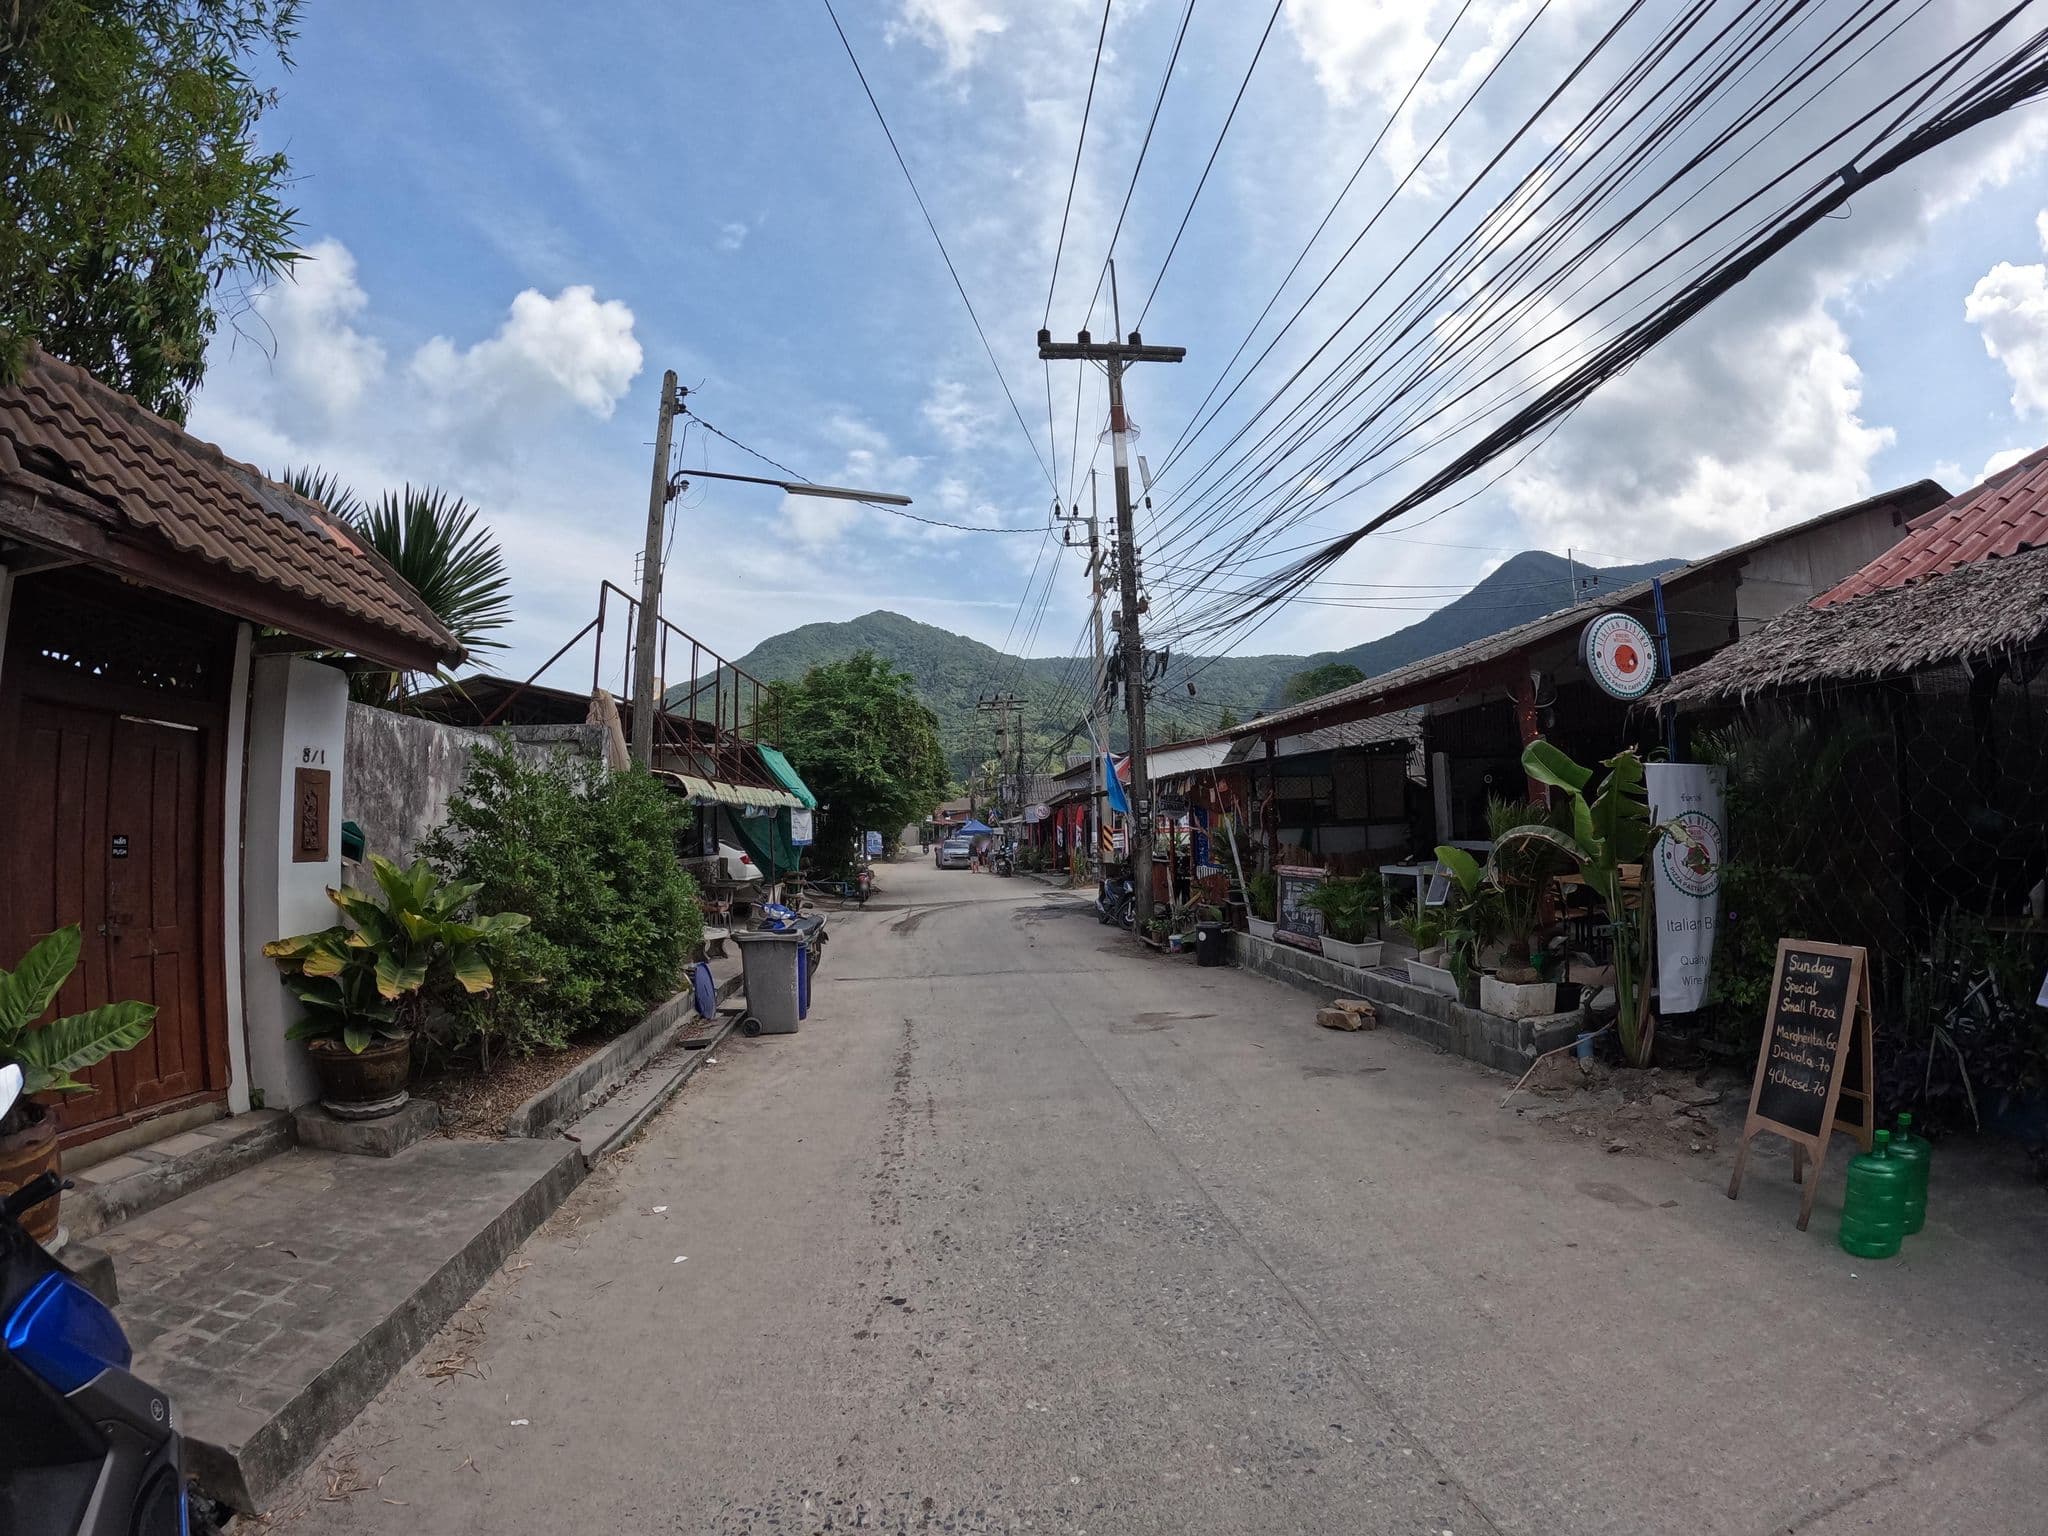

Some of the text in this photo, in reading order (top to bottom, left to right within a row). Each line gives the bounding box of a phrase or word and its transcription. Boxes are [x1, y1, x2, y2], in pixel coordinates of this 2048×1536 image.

[1624, 621, 1650, 648] BISTRO
[1789, 954, 1834, 978] Sunday
[1785, 976, 1819, 997] Special
[1781, 997, 1836, 1019] Small Pizza
